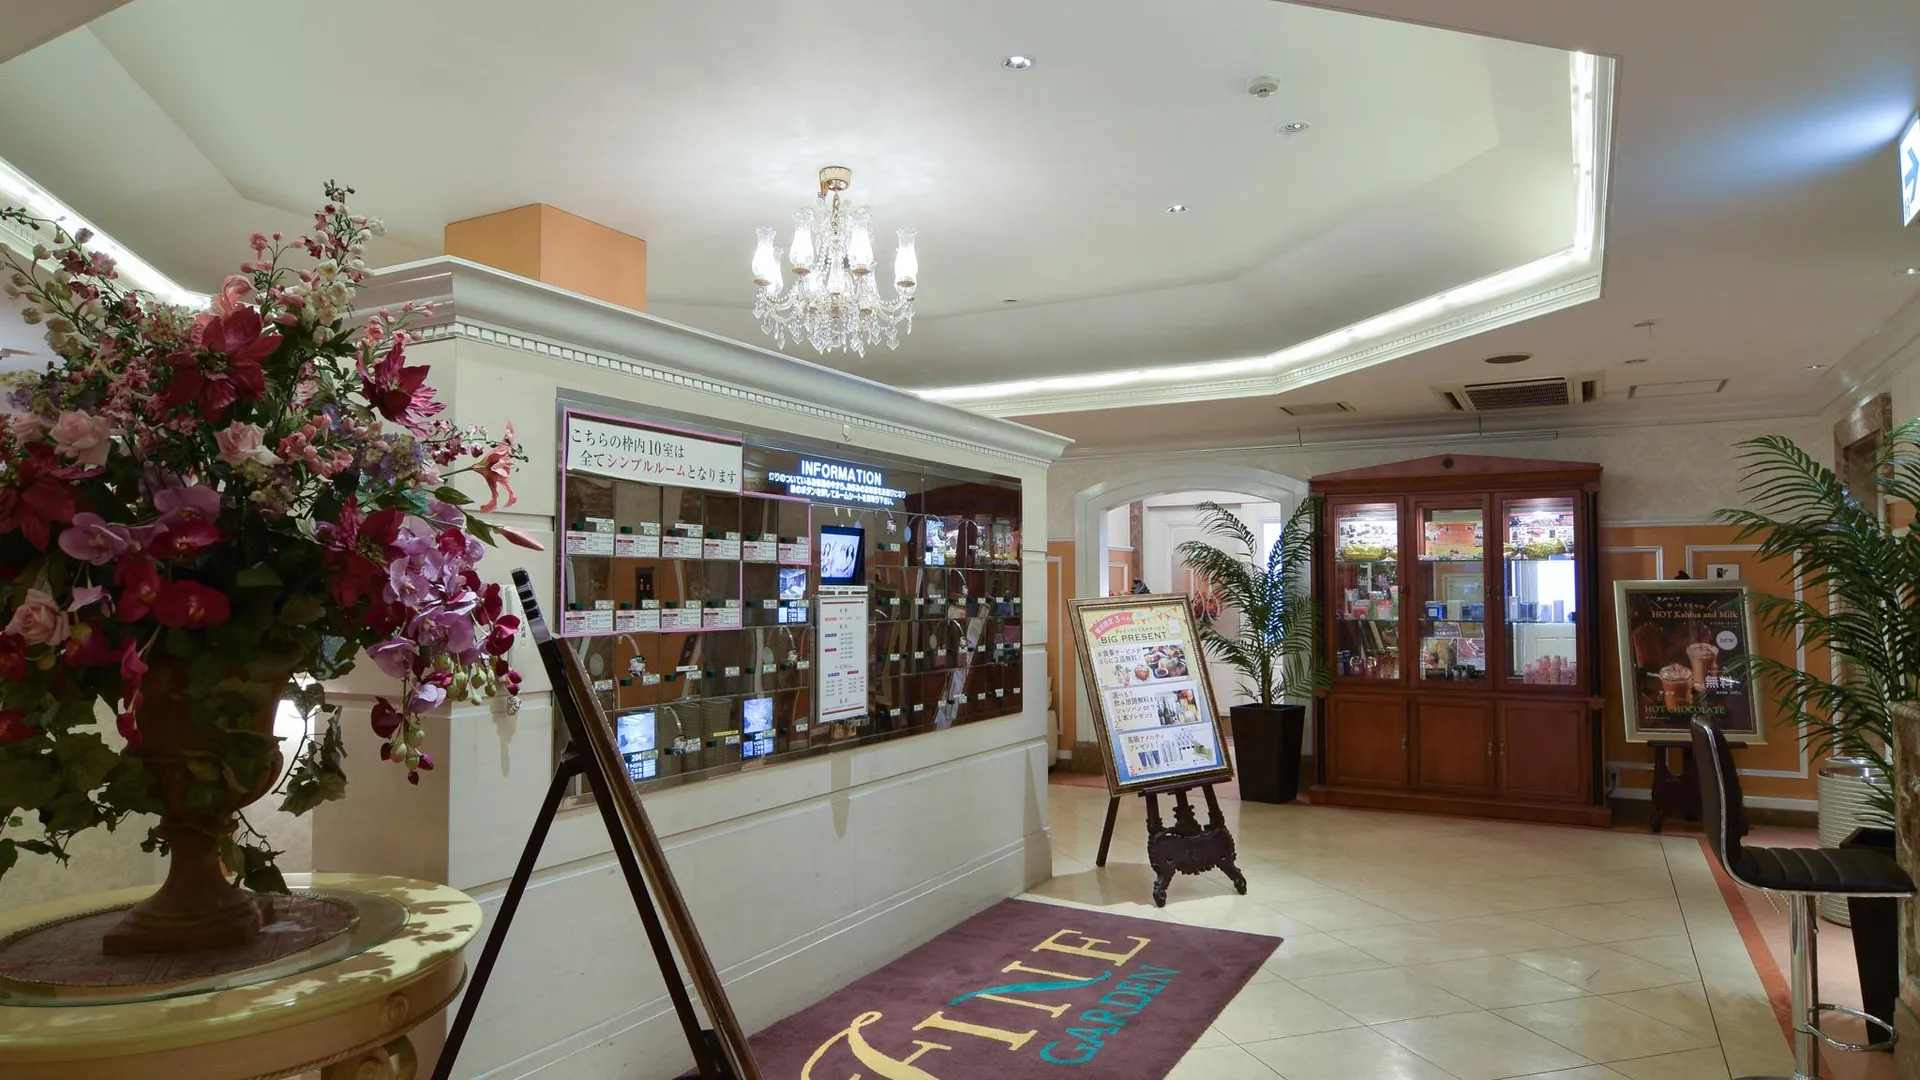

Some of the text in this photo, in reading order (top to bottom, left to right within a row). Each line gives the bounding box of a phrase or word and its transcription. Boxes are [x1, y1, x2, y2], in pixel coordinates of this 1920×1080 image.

[571, 428, 684, 458] こちらの枠内10室は
[580, 449, 737, 485] 全てシンプルルームとなります
[801, 459, 882, 486] INFORMATION
[1651, 610, 1672, 618] HOT
[1704, 610, 1717, 618] and
[1719, 610, 1738, 618] Milk
[1100, 631, 1167, 644] BIG PRESENT
[1705, 676, 1735, 689] 無料
[1644, 705, 1726, 714] HOT CHOCOLATE
[1039, 963, 1181, 1065] GARDEN
